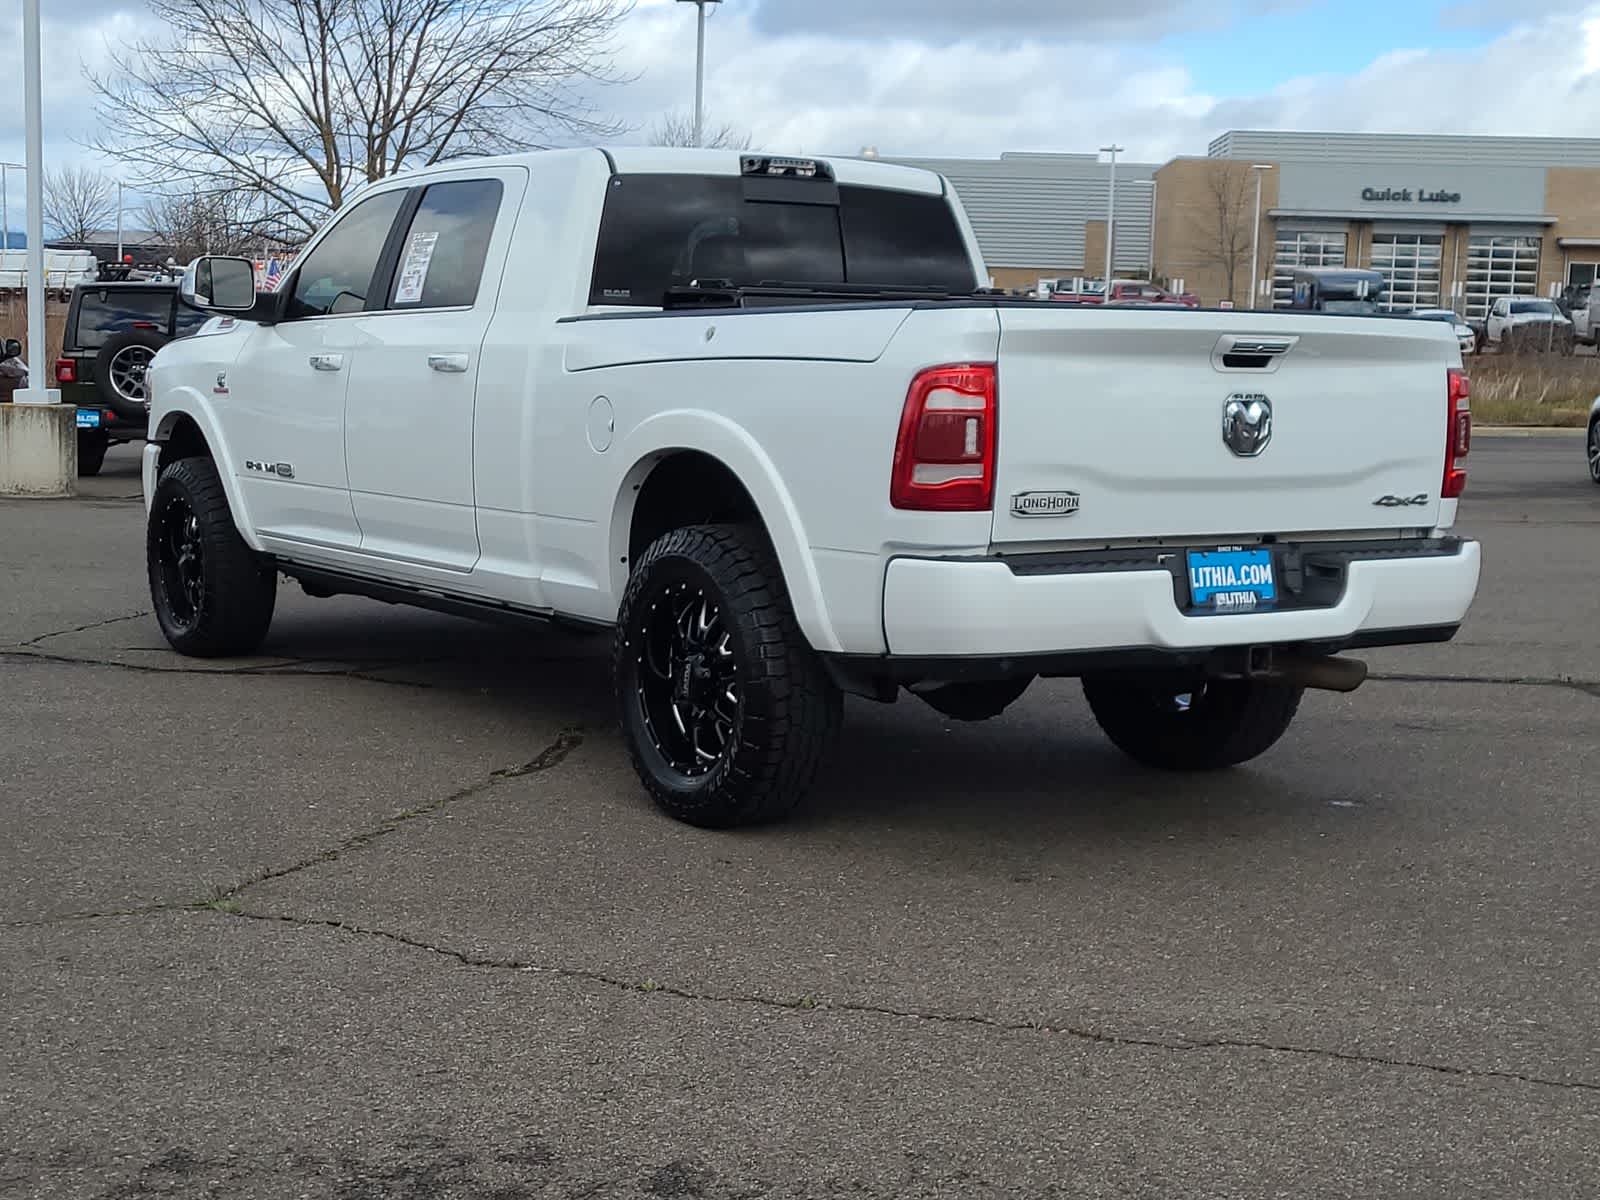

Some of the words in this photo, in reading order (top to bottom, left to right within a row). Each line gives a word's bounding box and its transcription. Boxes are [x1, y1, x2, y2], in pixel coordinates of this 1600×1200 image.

[1362, 187, 1413, 201] Quick
[1418, 189, 1461, 202] Lube
[1191, 564, 1273, 588] LITHIA.COM
